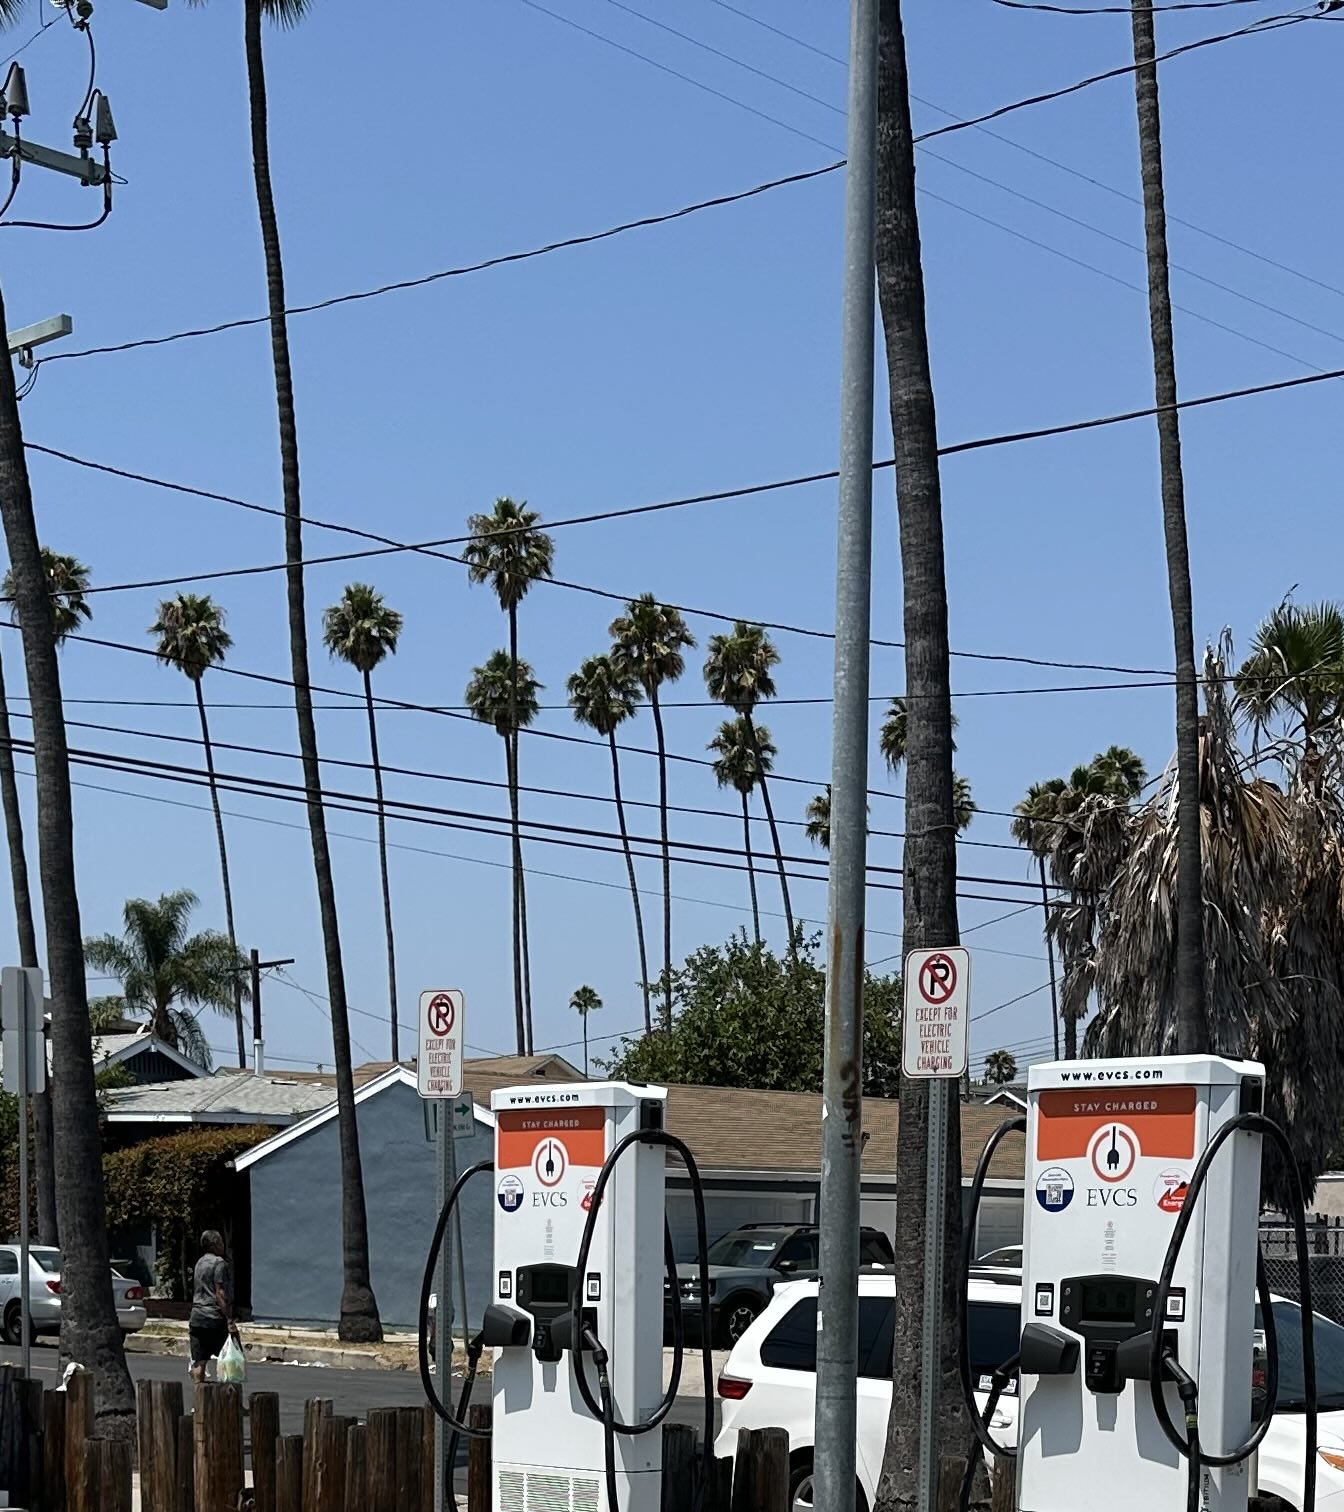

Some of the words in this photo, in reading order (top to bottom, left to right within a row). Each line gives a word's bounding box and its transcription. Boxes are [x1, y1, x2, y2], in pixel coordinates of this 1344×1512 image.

[915, 1007, 942, 1022] EXCEPT
[944, 1006, 958, 1021] FOR
[919, 1023, 952, 1038] ELECTRIC
[921, 1039, 950, 1054] VEHICLE
[917, 1055, 953, 1071] CHARGING
[1060, 1069, 1163, 1082] www.evcs.com
[509, 1093, 579, 1105] www.evcs.com
[1073, 1102, 1100, 1112] STAY
[1105, 1100, 1158, 1112] CHARGED
[522, 1120, 541, 1129] STAY
[543, 1119, 580, 1129] CHARGED
[532, 1191, 568, 1208] EVCS
[1086, 1188, 1138, 1207] EVCS
